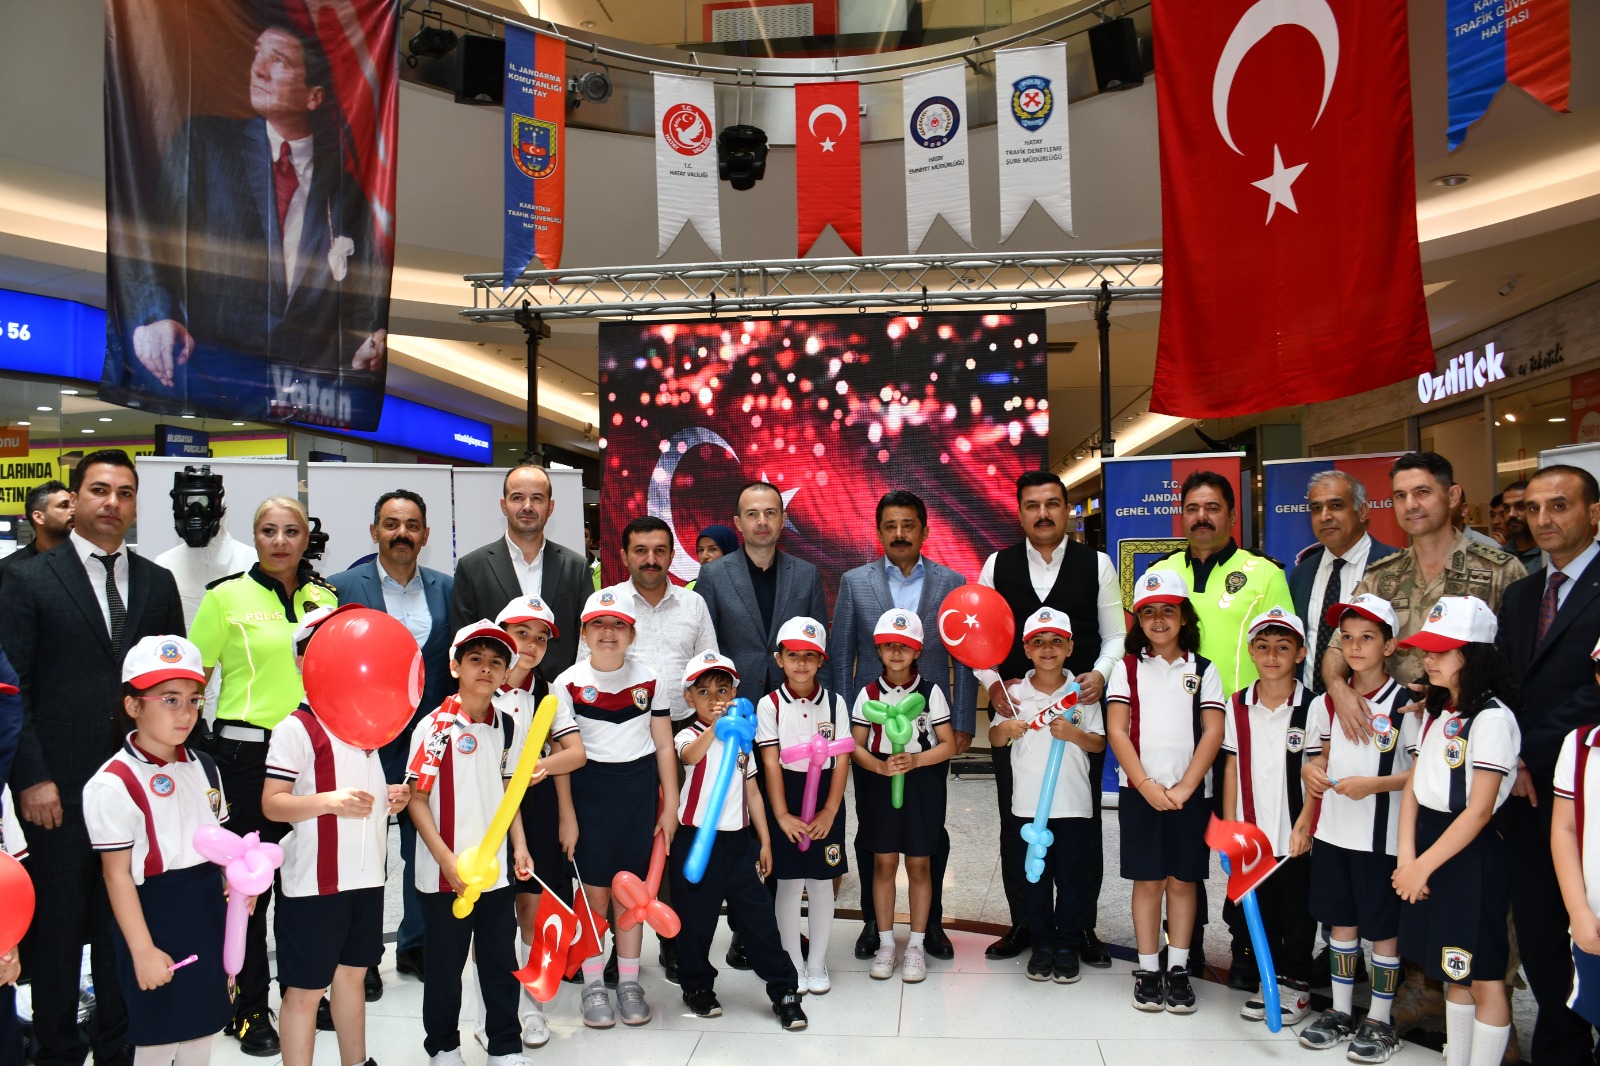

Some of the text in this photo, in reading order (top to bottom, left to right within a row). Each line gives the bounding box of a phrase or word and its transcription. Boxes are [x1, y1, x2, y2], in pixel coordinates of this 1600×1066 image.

[1454, 12, 1493, 37] TRAFİK
[1481, 9, 1530, 40] HAFTASI
[509, 62, 561, 83] İL JANDARMA
[508, 72, 562, 92] KOMUTANLIĞI
[522, 86, 547, 98] HATAY
[665, 133, 680, 150] HATAY
[1027, 145, 1062, 154] DENETLEME
[1023, 152, 1063, 163] MÜDÜRLÜĞÜ
[519, 202, 551, 212] KARAYOLU
[522, 222, 548, 231] HAFTASI
[8, 321, 31, 341] 56
[271, 364, 351, 421] Vatan
[1162, 480, 1182, 489] T.C.
[1115, 507, 1150, 517] GENEL
[1275, 504, 1311, 514] GENEL
